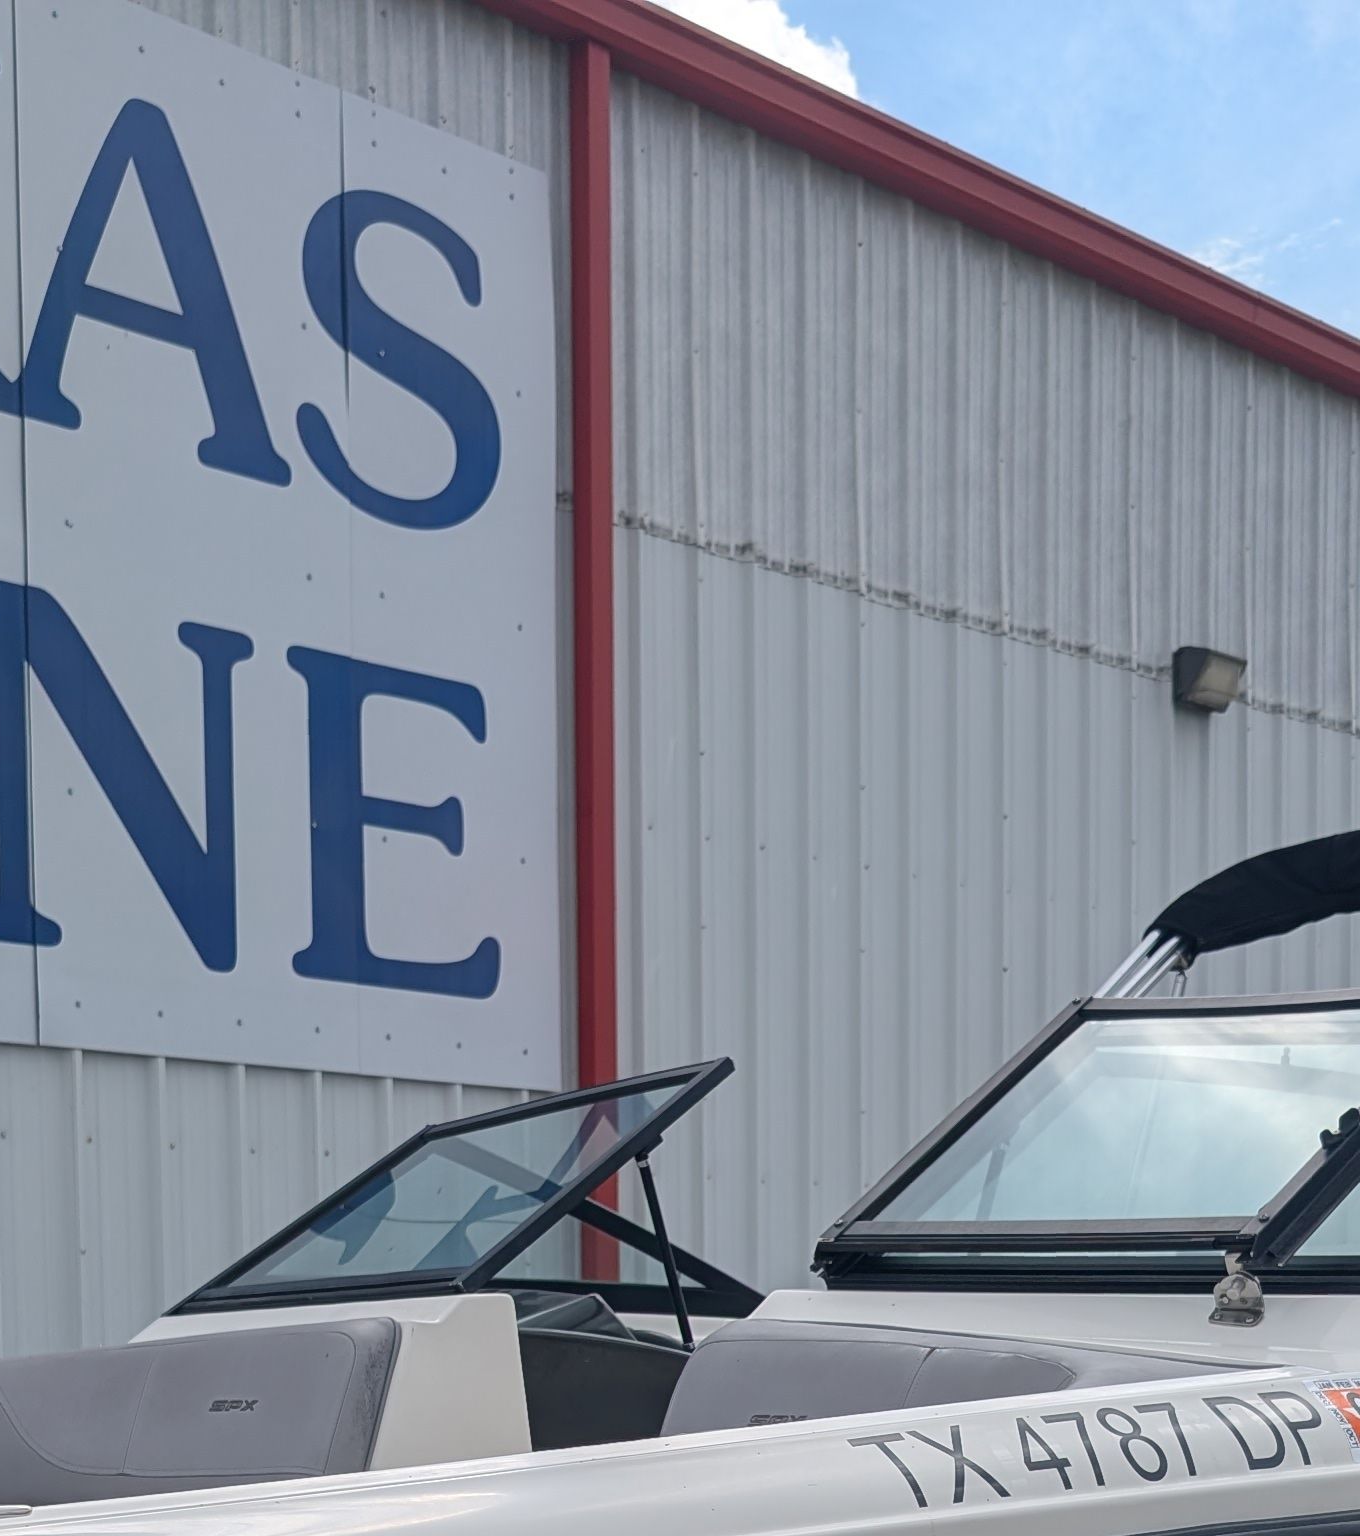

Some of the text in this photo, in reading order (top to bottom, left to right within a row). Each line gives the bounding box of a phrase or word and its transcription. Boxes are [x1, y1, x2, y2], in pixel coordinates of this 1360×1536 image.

[208, 1399, 259, 1413] SPX
[846, 1391, 1323, 1508] TX 4787 DP
